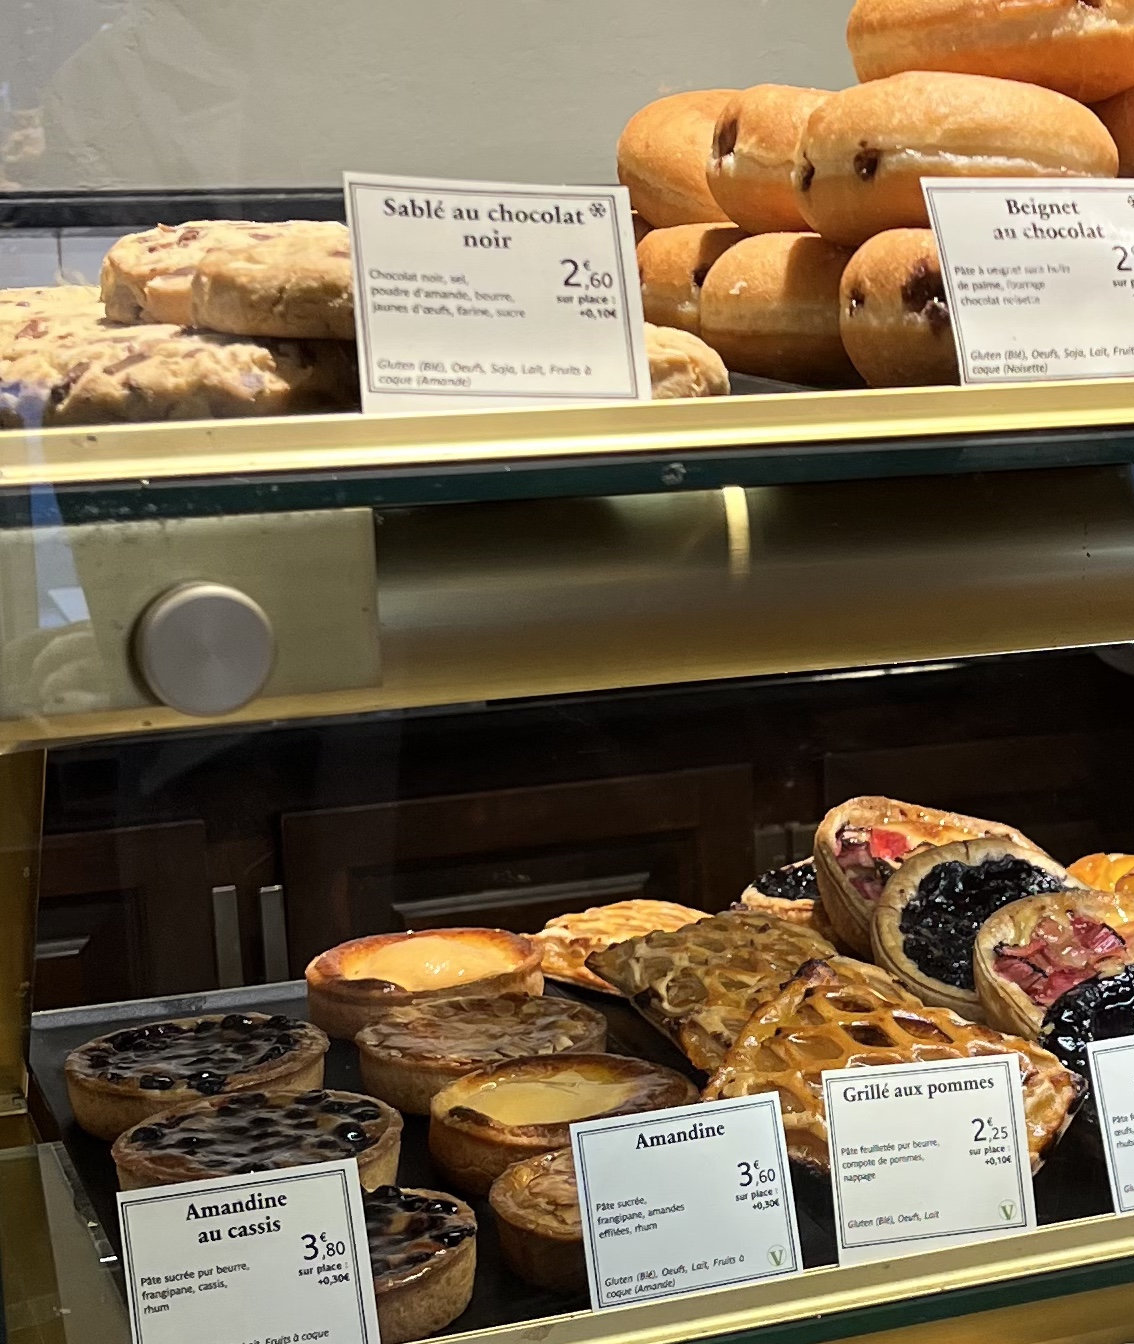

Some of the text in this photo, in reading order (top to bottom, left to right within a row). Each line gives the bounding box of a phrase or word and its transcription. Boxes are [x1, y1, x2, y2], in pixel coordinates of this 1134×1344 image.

[383, 198, 585, 225] Sablé au chocolat
[1005, 198, 1080, 220] Beignet
[463, 230, 512, 250] noir
[994, 222, 1105, 240] au chocolat
[1112, 279, 1128, 288] sur
[556, 296, 574, 305] sur
[1003, 363, 1048, 375] (Noisette)
[843, 1077, 995, 1103] Grillé aux pommes
[636, 1123, 726, 1150] Amandine
[186, 1192, 288, 1221] Amandine
[198, 1215, 282, 1244] au cassis
[140, 1274, 162, 1287] Pâte
[164, 1270, 195, 1284] sucrée
[197, 1268, 214, 1281] pur
[298, 1261, 343, 1277] sur place
[141, 1284, 196, 1301] frangipane,
[143, 1302, 170, 1315] rhum
[293, 1333, 300, 1343] à
[302, 1328, 329, 1342] coque
